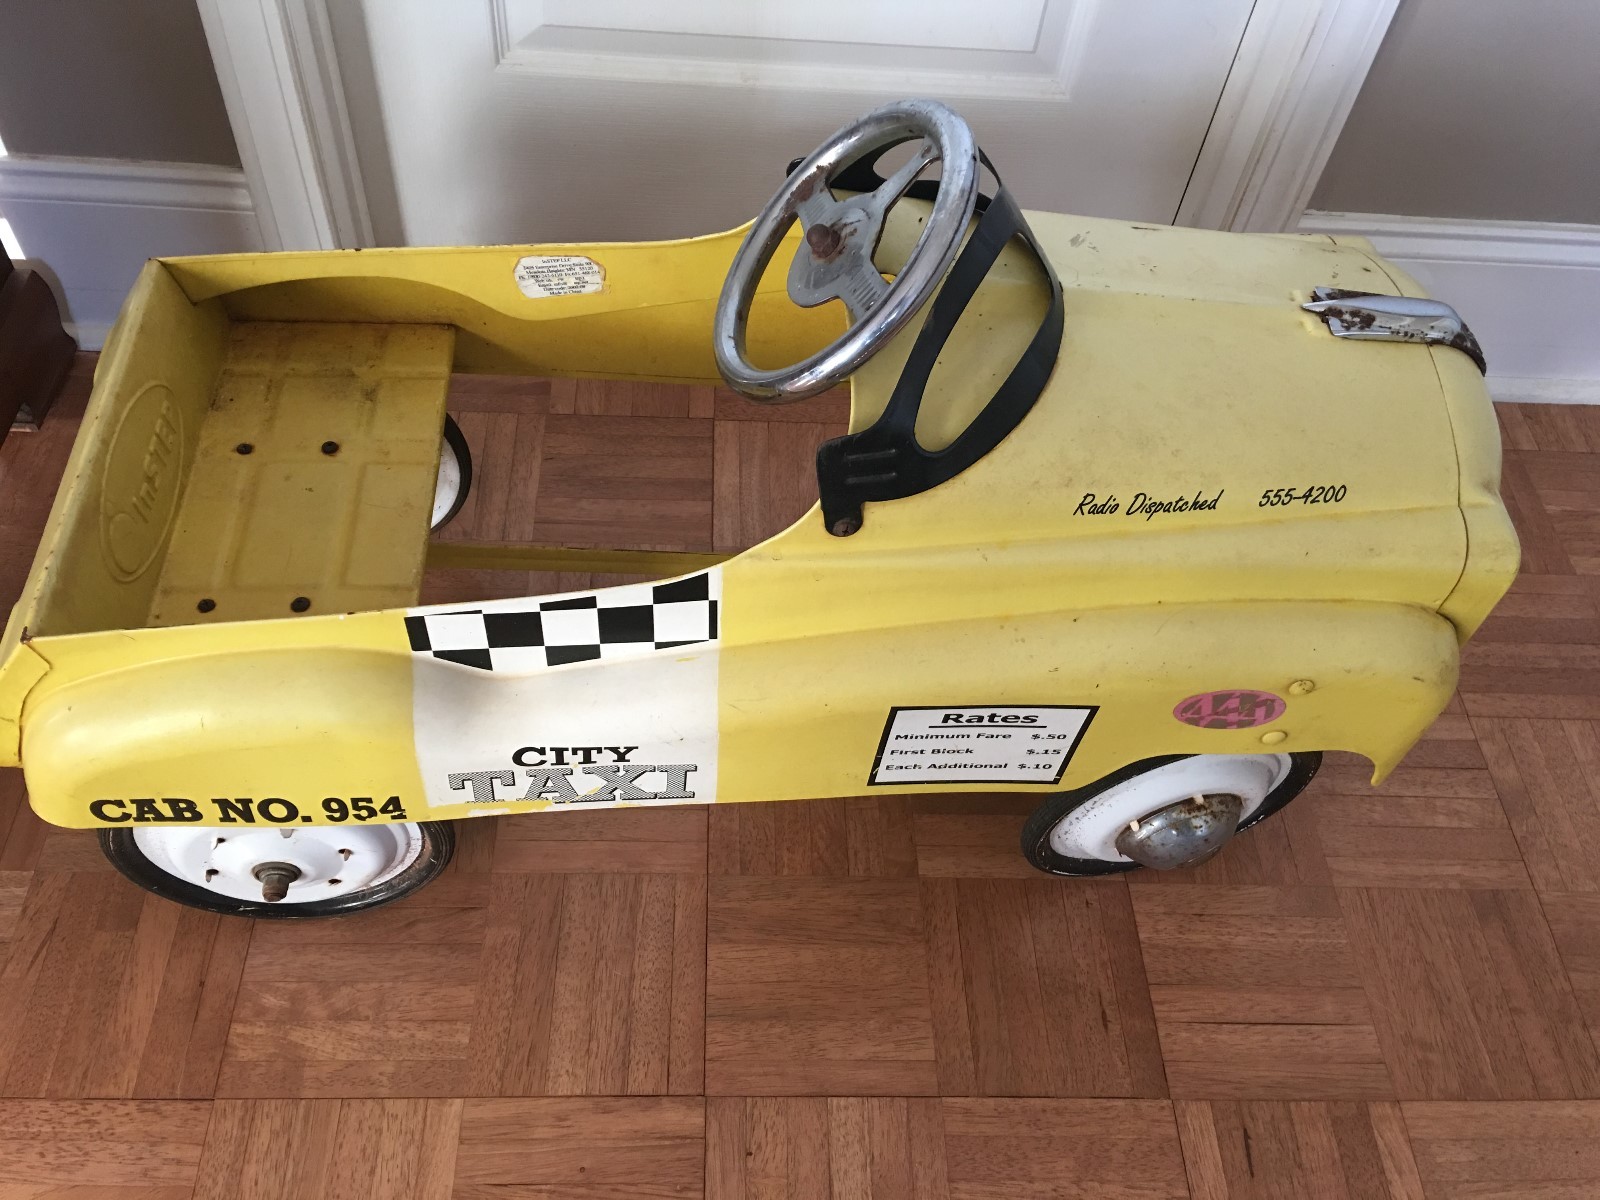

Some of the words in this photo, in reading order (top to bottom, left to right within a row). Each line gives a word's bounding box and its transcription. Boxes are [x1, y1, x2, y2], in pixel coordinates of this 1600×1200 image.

[1073, 492, 1120, 516] Radio
[1125, 489, 1225, 521] Dispatched
[1258, 484, 1347, 507] 555-4200
[941, 712, 1039, 724] Rates
[894, 733, 971, 741] Minimum
[976, 732, 1012, 740] Fare
[1031, 733, 1067, 741] $.50
[511, 746, 639, 767] CITY
[927, 762, 1008, 770] Additional
[448, 764, 698, 804] TAXI
[90, 798, 204, 823] CAB
[211, 798, 313, 823] NO.
[321, 796, 407, 822] 954
